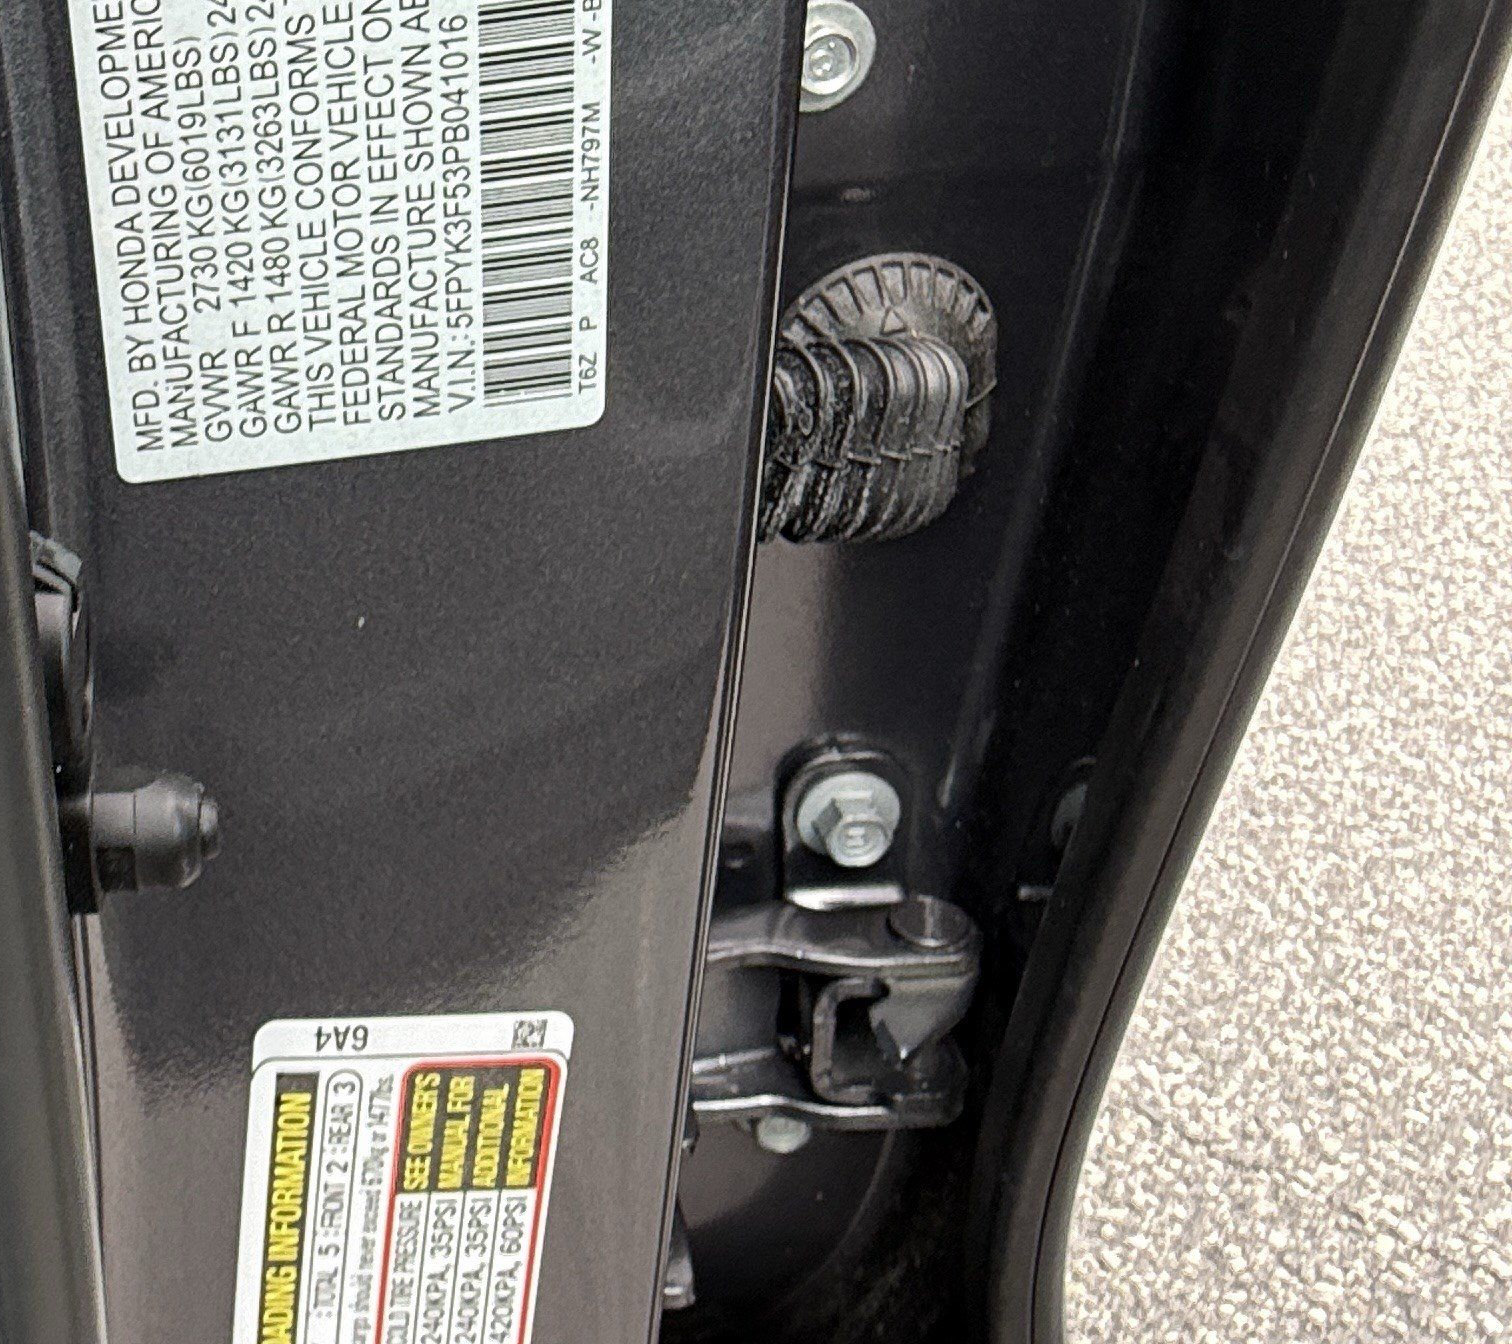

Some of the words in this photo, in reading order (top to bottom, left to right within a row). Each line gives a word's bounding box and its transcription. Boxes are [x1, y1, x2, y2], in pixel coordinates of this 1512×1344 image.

[284, 13, 325, 210] CONFORMS
[322, 1, 359, 151] VEHICLE
[401, 43, 435, 172] SHOWN
[142, 132, 175, 175] OF
[362, 54, 398, 184] EFFECT
[580, 102, 601, 210] -NH797M
[330, 157, 364, 278] MOTOR
[369, 194, 399, 225] IN
[114, 211, 152, 326] HONDA
[188, 246, 222, 314] 2730
[224, 241, 256, 307] 1420
[260, 236, 292, 303] 1480
[296, 218, 332, 356] VEHICLE
[580, 236, 599, 283] AC8
[147, 184, 198, 448] MANUFACTURING
[231, 321, 260, 338] F
[267, 310, 296, 334] R
[370, 234, 406, 421] STANDARDS
[405, 181, 441, 418] MANUFACTURE
[579, 316, 597, 331] P
[125, 335, 157, 373] BY
[269, 340, 302, 434] GAWR
[337, 284, 371, 426] FEDERAL
[578, 352, 597, 394] T6Z
[132, 381, 165, 452] MFD.
[198, 348, 233, 442] GVWR
[234, 345, 268, 438] GAWR
[305, 362, 336, 432] THIS
[314, 1024, 369, 1053] 6A4
[332, 1080, 356, 1095] 3
[407, 1074, 439, 1155] OWNER'S
[447, 1076, 474, 1113] FOR
[437, 1113, 470, 1190] MANUAL
[472, 1087, 508, 1188] ADDITIONAL
[505, 1068, 545, 1187] INFORMATION
[267, 1091, 311, 1262] INFORMATION
[325, 1160, 349, 1174] 2
[403, 1156, 430, 1191] SEE
[317, 1243, 341, 1257] 5
[392, 1200, 423, 1274] PRESSURE
[429, 1198, 458, 1259] 35PSI
[464, 1197, 493, 1258] 35PSI
[499, 1195, 528, 1255] 60PSI
[388, 1277, 415, 1308] TIRE
[489, 1261, 523, 1344] 420KPA,
